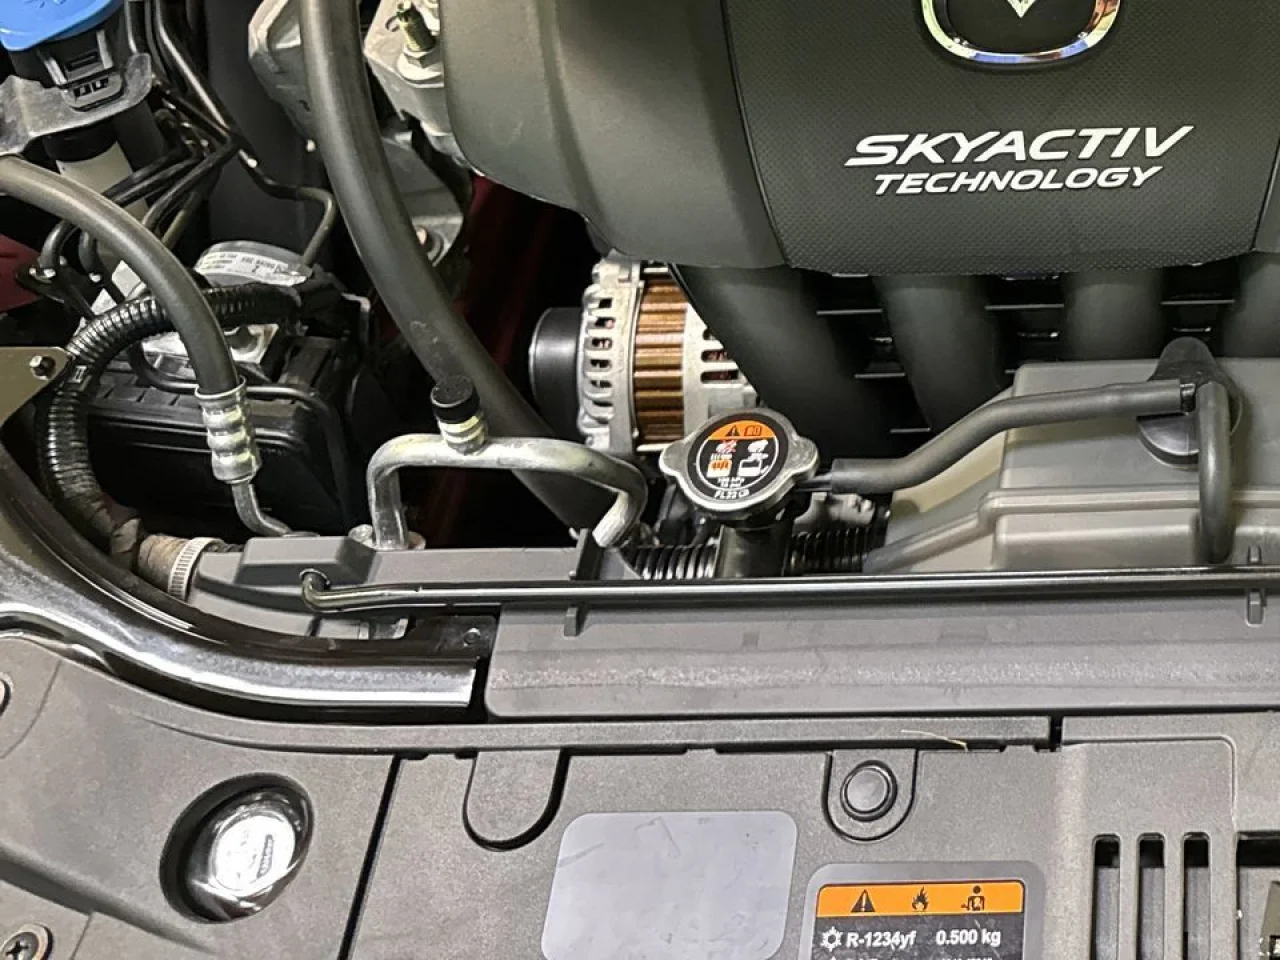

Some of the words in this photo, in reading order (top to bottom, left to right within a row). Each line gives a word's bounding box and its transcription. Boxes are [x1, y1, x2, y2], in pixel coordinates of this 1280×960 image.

[844, 125, 1195, 167] SKYACTIV
[874, 166, 1164, 196] TECHNOLOGY
[846, 930, 917, 949] R-1234yf
[936, 929, 978, 946] 0.500
[982, 928, 1001, 948] kg
